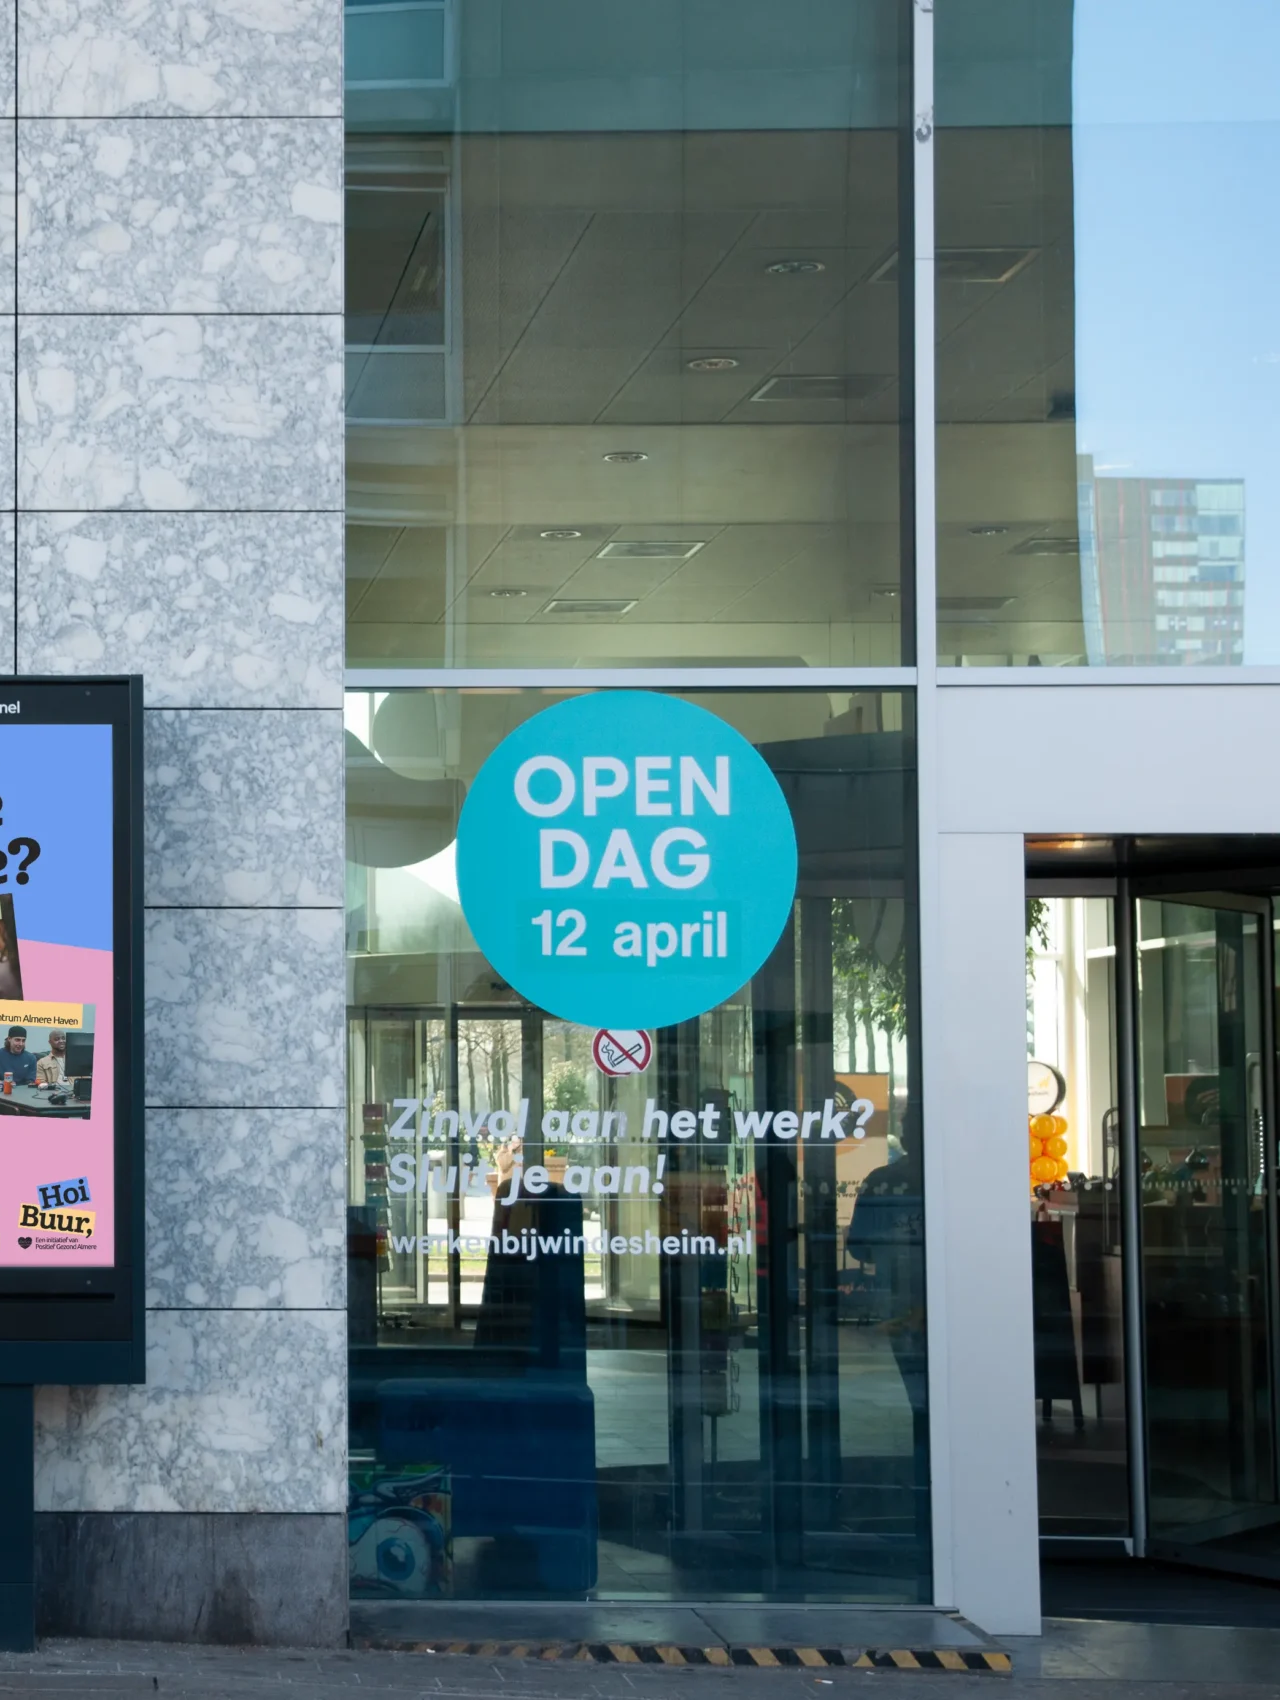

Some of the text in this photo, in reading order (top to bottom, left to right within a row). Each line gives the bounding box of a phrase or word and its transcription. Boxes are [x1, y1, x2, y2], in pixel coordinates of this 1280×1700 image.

[514, 755, 730, 818] OPEN
[539, 827, 711, 890] DAG
[532, 909, 728, 967] 12 april
[23, 1014, 52, 1024] Almere
[53, 1016, 78, 1025] Haven
[389, 1098, 875, 1139] Zinvol aan het werk?
[39, 1179, 89, 1209] Hoi
[387, 1153, 666, 1206] Sluit je aan!
[20, 1204, 92, 1238] Buur,
[392, 1228, 752, 1260] werkenbijwindesheim.nl
